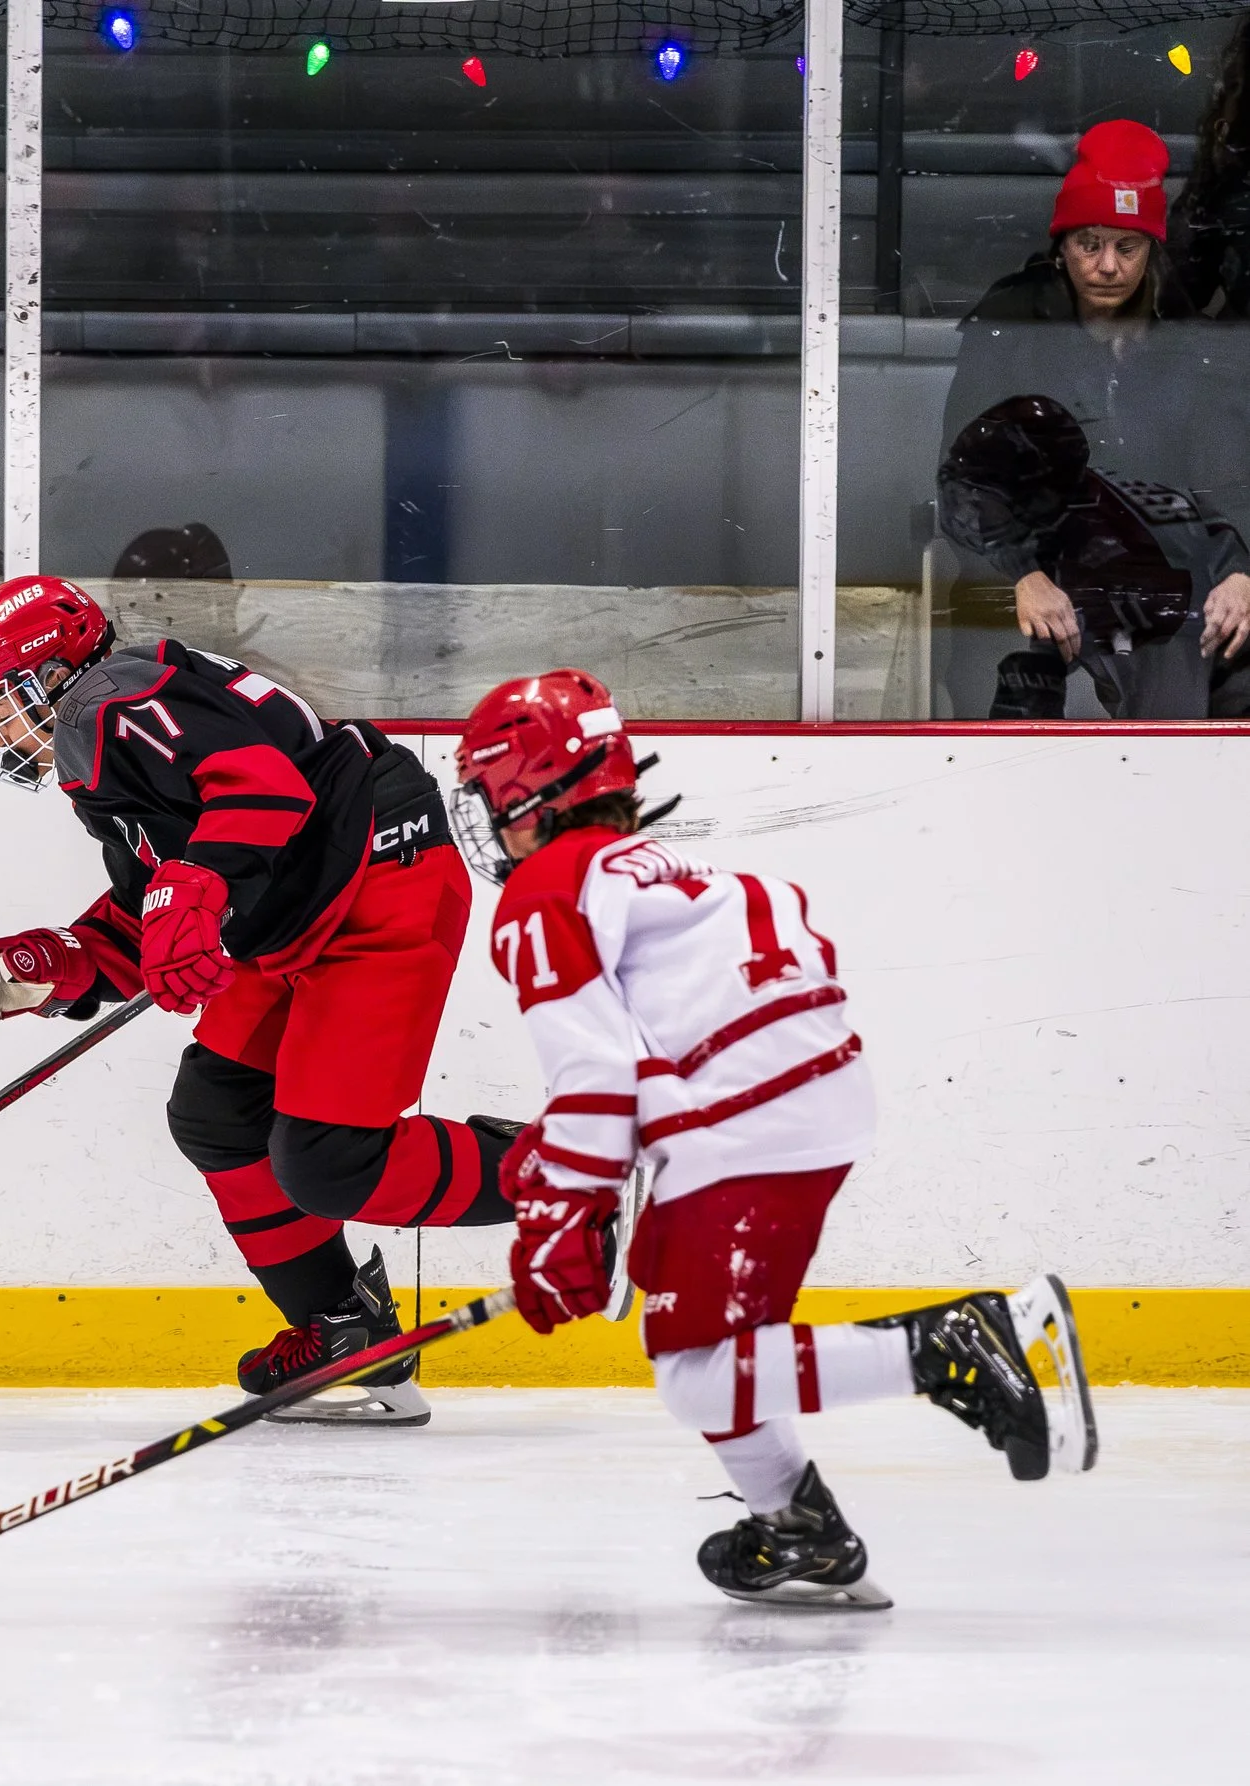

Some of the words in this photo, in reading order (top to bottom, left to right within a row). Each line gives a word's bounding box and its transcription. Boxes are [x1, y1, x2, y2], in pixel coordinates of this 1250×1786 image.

[20, 629, 58, 654] CCM
[115, 698, 184, 764] 77
[372, 814, 430, 852] CM
[494, 911, 559, 990] 71
